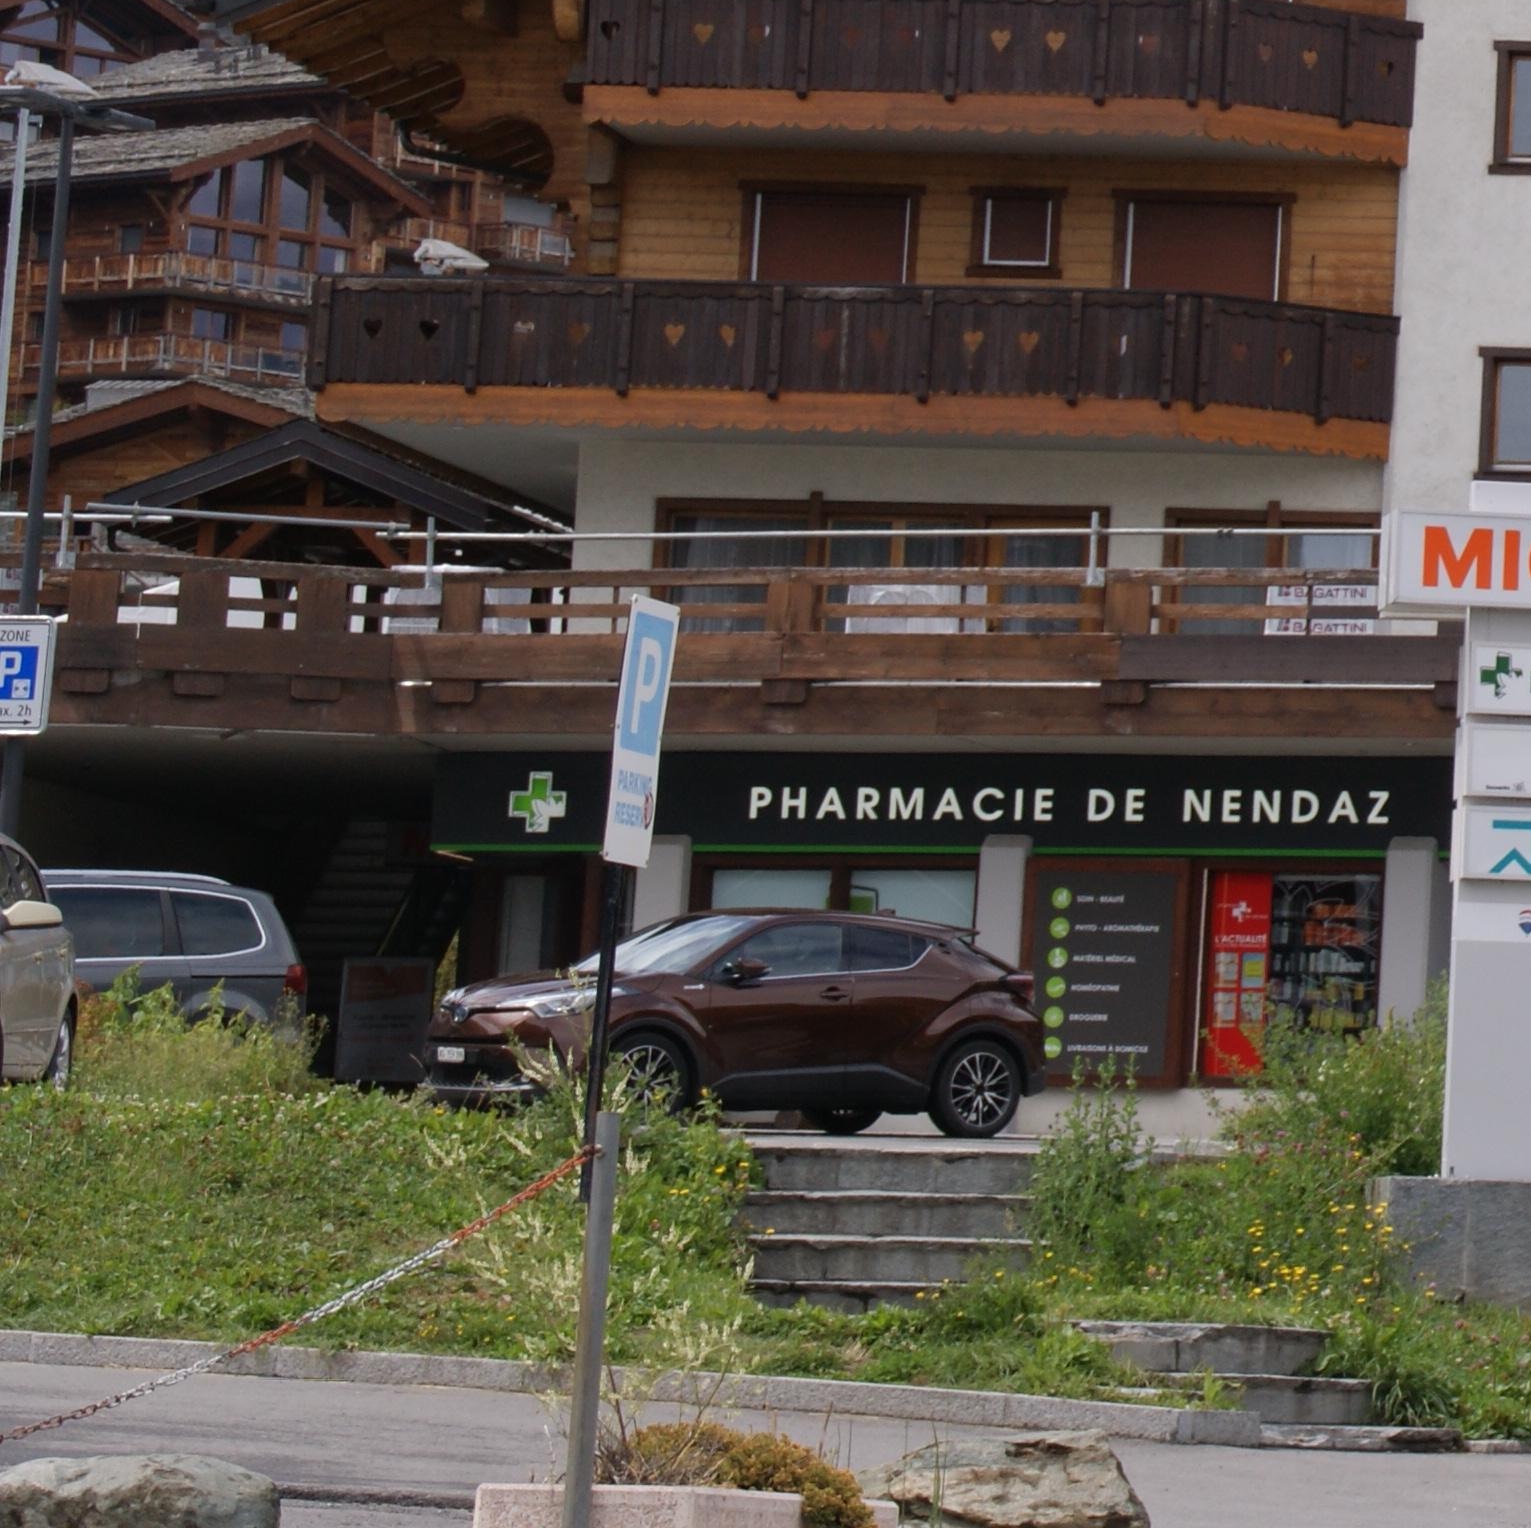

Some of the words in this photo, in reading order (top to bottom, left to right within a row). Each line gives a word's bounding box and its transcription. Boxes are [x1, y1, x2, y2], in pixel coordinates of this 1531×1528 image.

[1294, 587, 1367, 599] BGATTINI
[1292, 621, 1367, 633] BGATTINI
[629, 636, 662, 735] P
[17, 704, 32, 717] 2h
[618, 769, 652, 795] PARKING
[748, 786, 1056, 822] PHARMACIE
[1087, 788, 1147, 823] DE
[1183, 789, 1391, 825] NENDAZ
